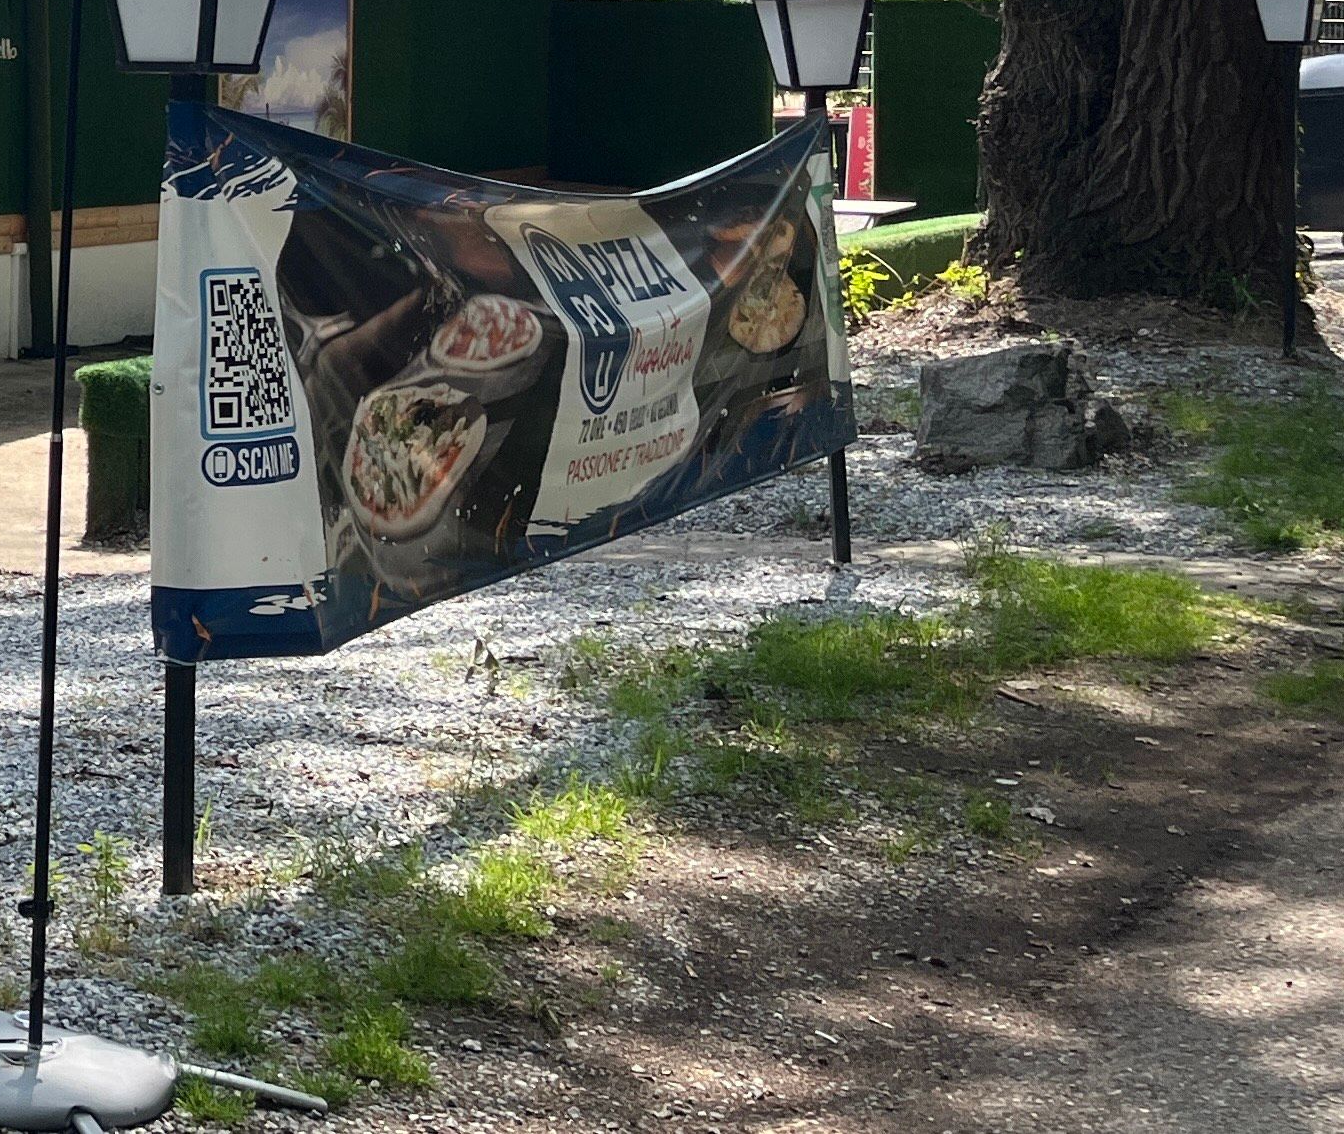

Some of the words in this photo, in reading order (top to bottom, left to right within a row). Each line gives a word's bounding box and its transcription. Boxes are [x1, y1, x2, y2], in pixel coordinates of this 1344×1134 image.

[577, 234, 687, 305] PIZZA
[570, 294, 616, 336] PO
[594, 351, 614, 397] LI
[237, 446, 279, 480] SCAN
